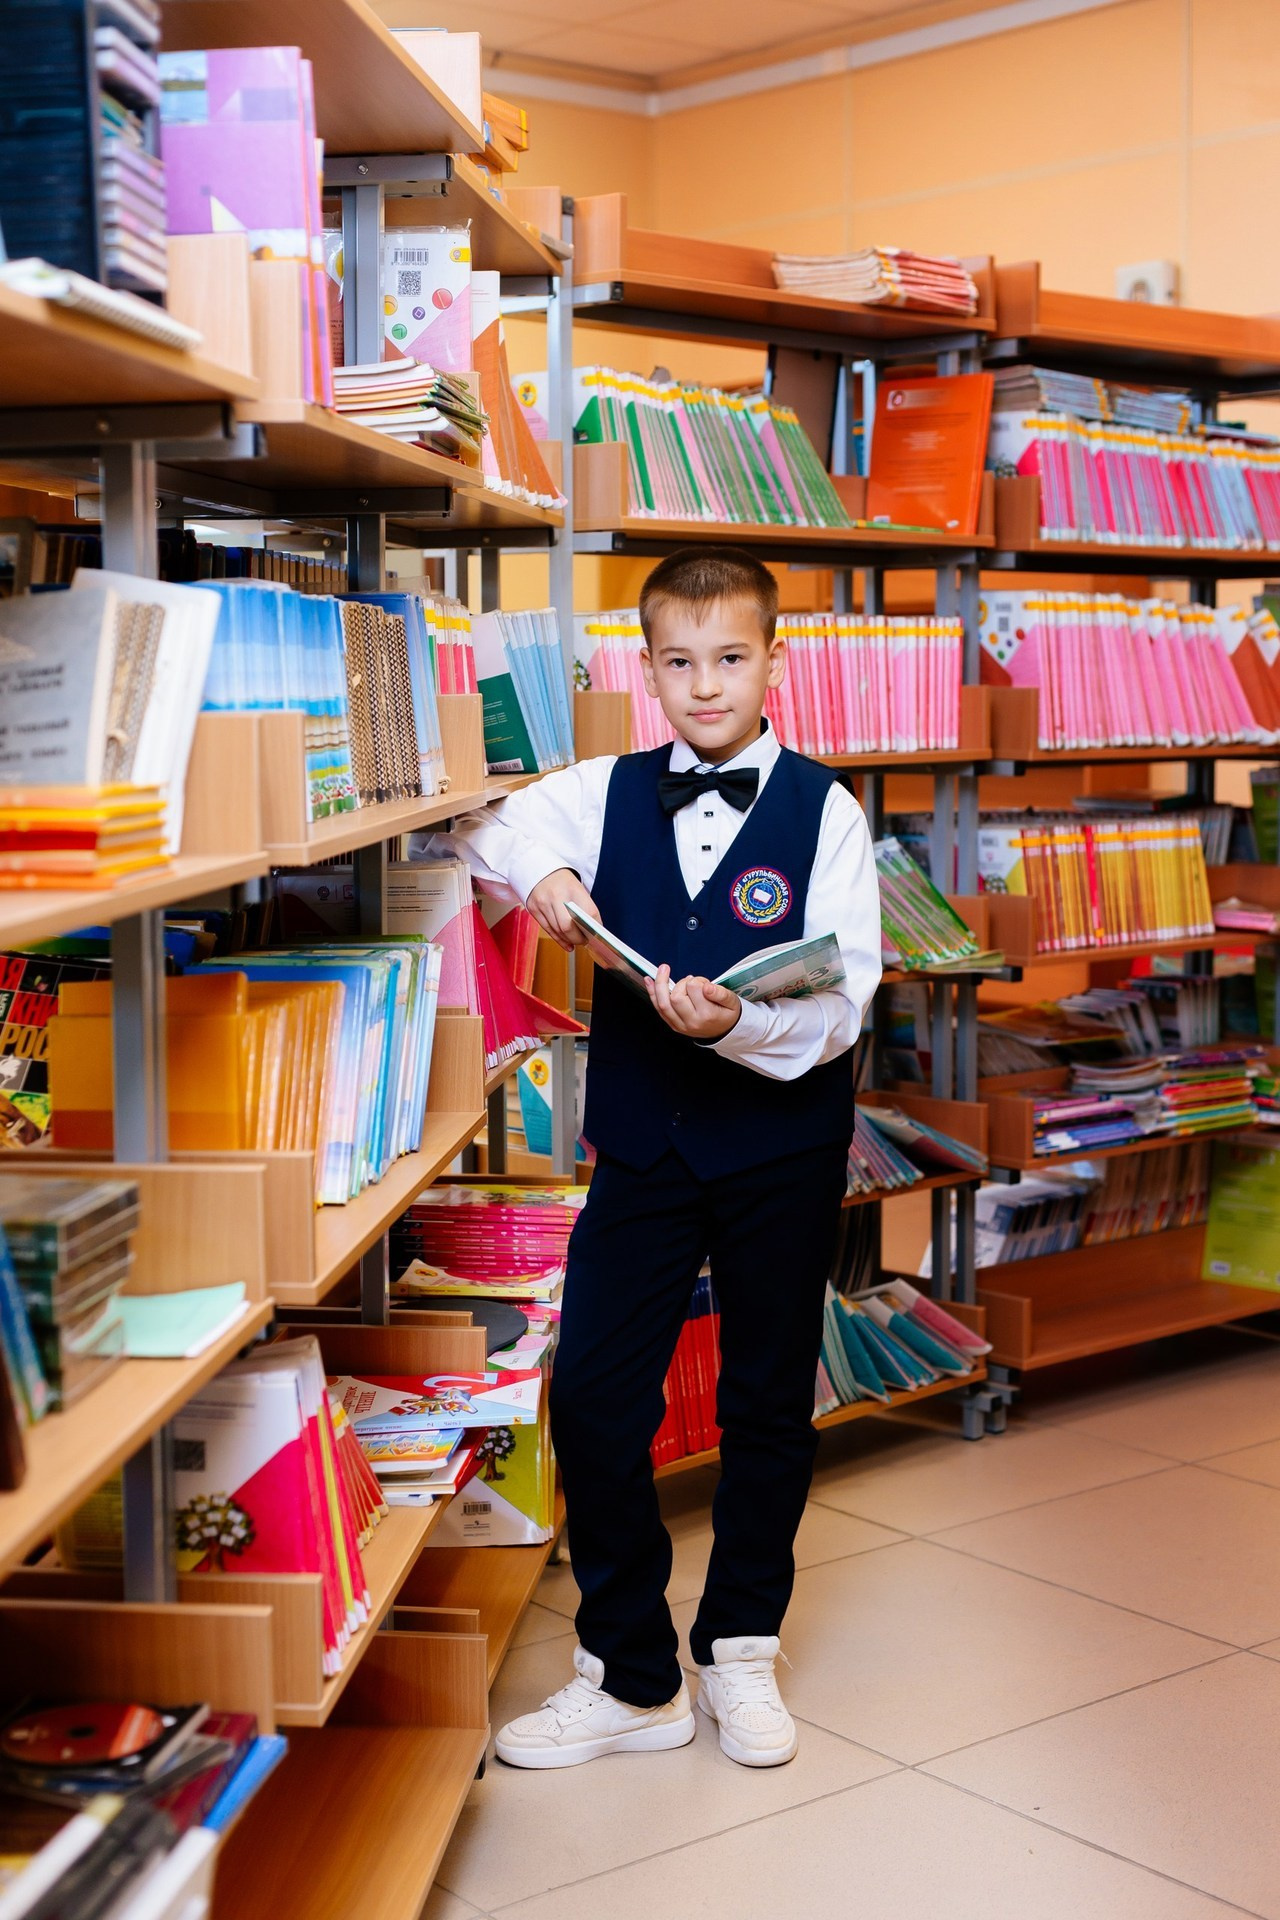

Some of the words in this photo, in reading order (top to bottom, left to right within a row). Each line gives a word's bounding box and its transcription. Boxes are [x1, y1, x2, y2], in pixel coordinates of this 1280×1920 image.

[733, 882, 743, 897] МОУ
[808, 966, 830, 982] 3
[354, 1391, 376, 1414] ЧТЕНИЕ
